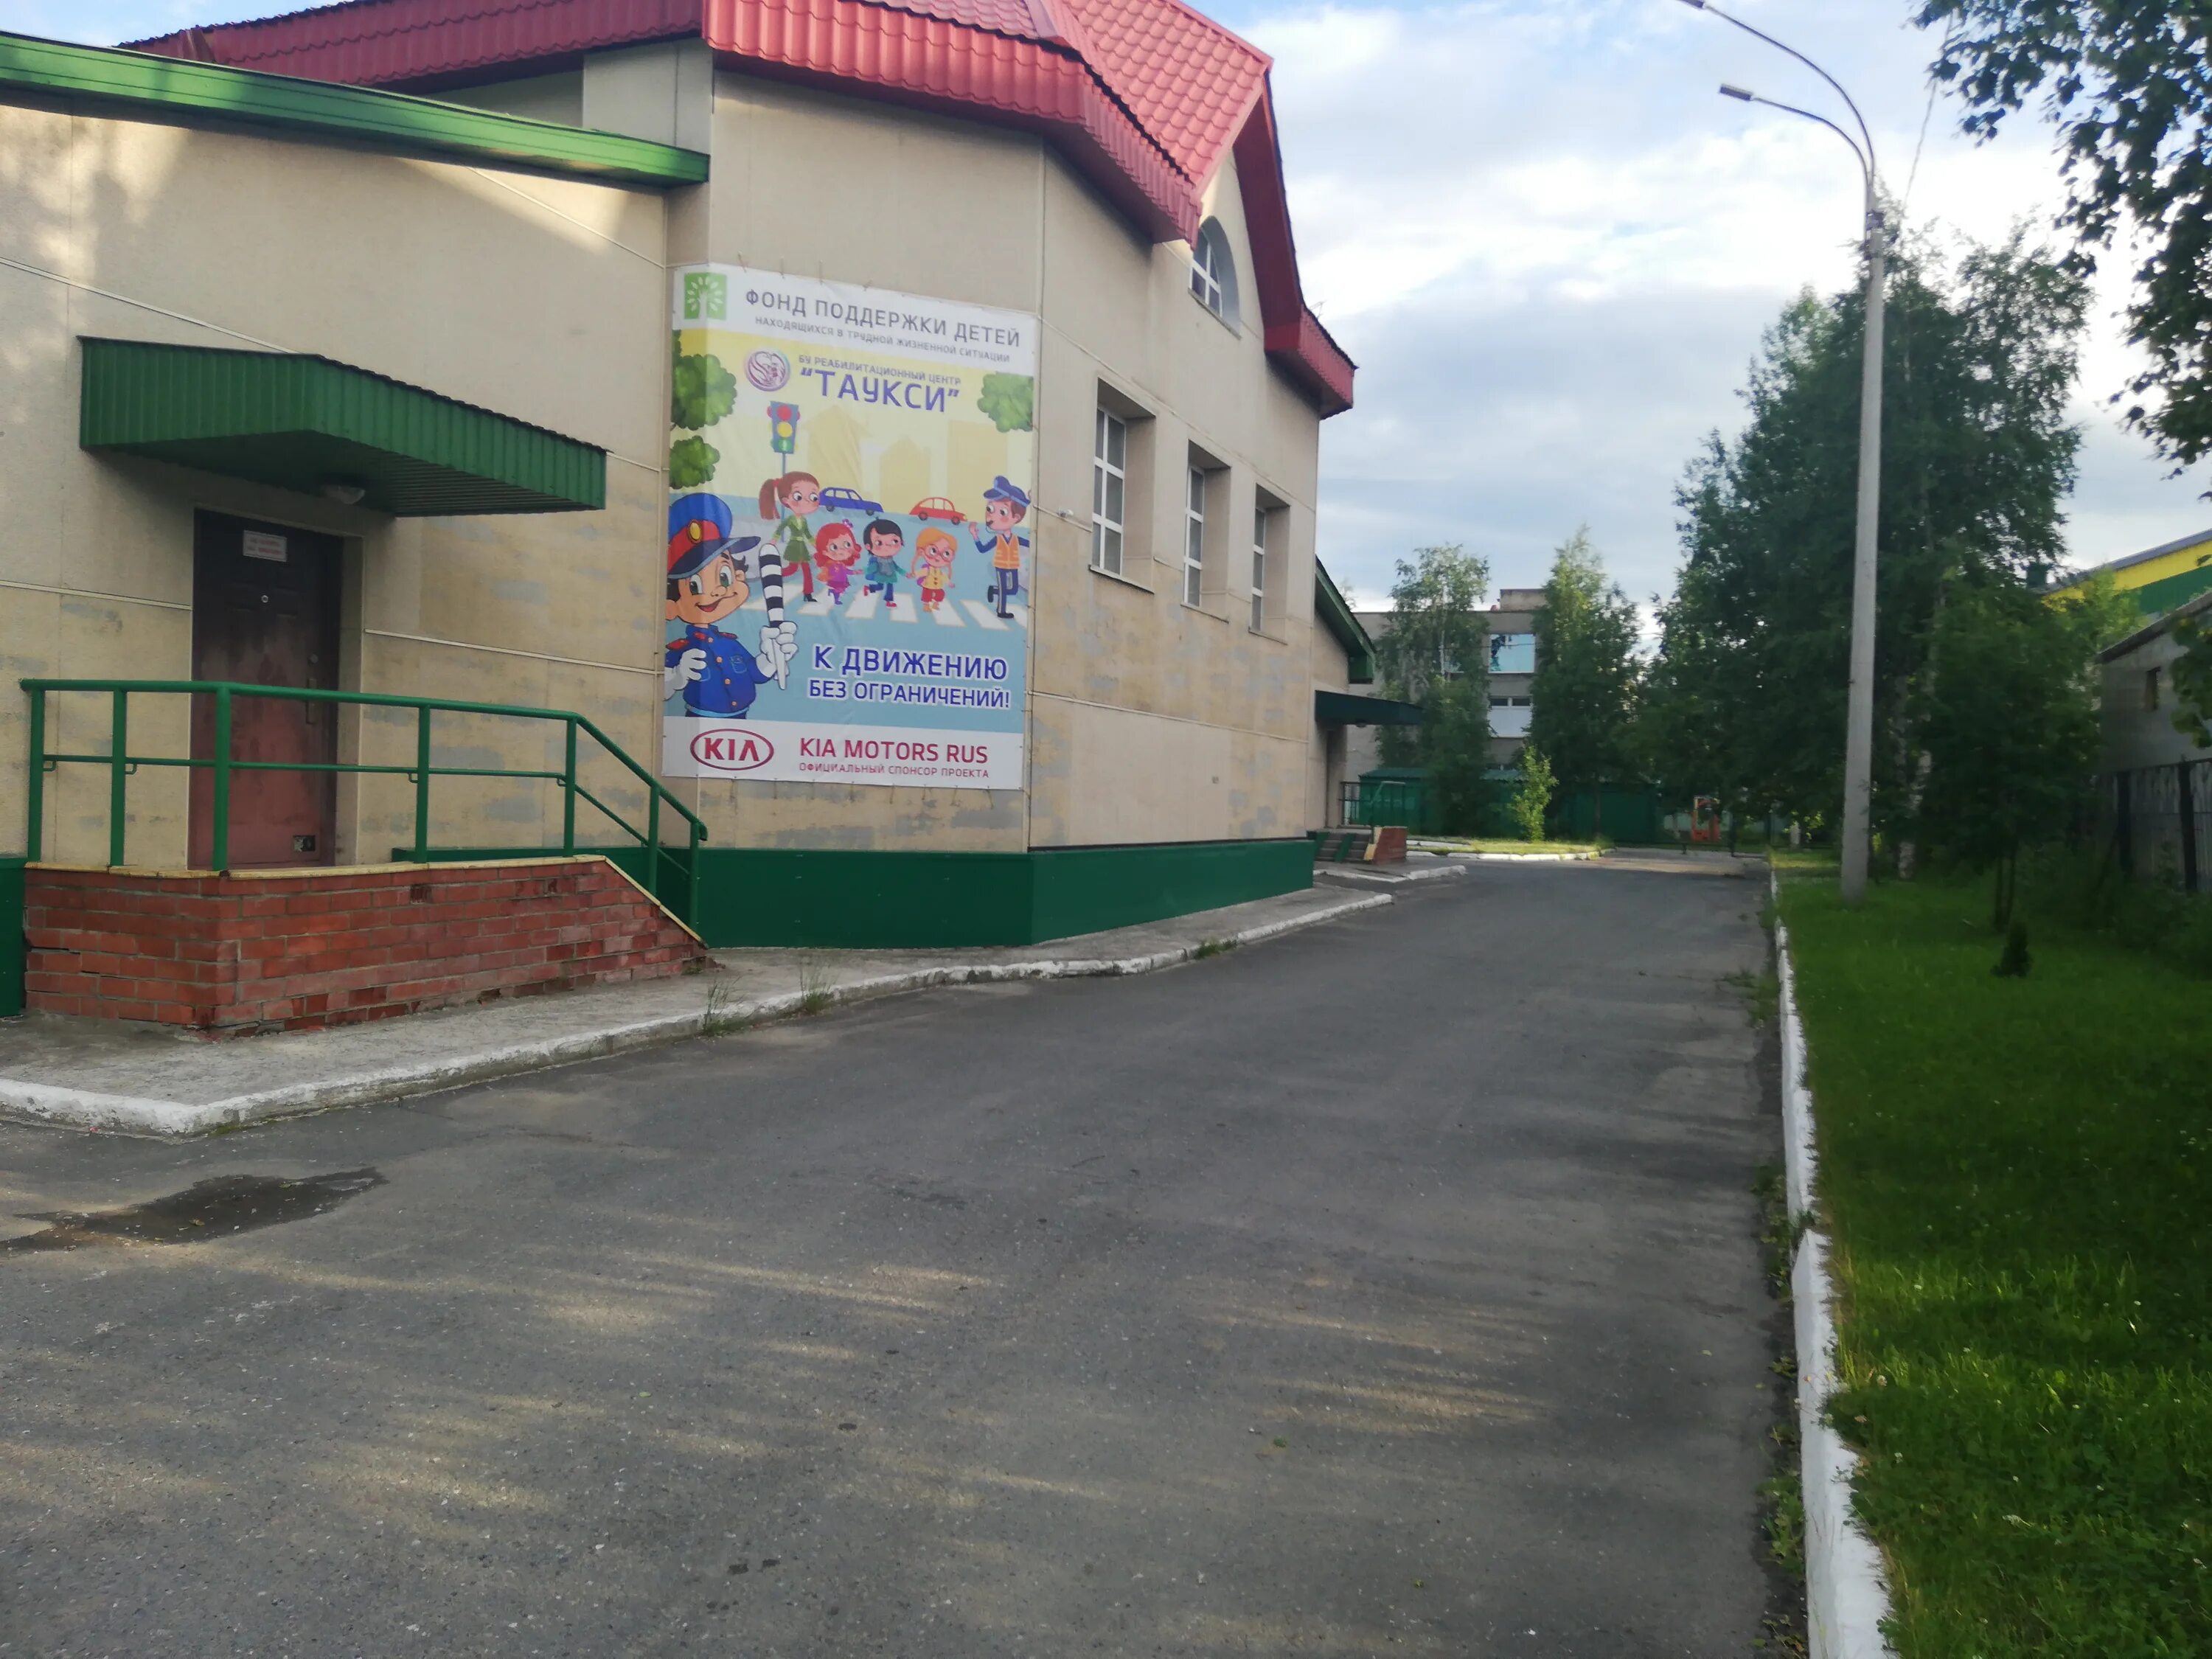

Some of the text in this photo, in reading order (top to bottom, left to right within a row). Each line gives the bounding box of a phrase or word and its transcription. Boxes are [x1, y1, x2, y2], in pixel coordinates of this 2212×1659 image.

[745, 289, 1020, 347] ФОНД ПОДДЕРЖКИ ДЕТЕЙ
[755, 316, 1009, 363] НАХОДЯЩИХСЯ В ТРУДНОЙ ЖИЗНЕННОЙ СИТУАЦИИ
[799, 355, 961, 386] БУ РЕАБИЛИТАЦИОННЫЙ ЦЕНТР
[815, 647, 1007, 680] К ДВИЖЕНИЮ
[810, 680, 1010, 708] БЕЗ ОГРАНИЧЕНИЙ!
[704, 737, 760, 762] KIA
[800, 738, 988, 764] KIA MOTORS RUS
[799, 762, 989, 779] ОФИЦИАЛЬНЫЙ СПОНСОР ПРОЕКТА
